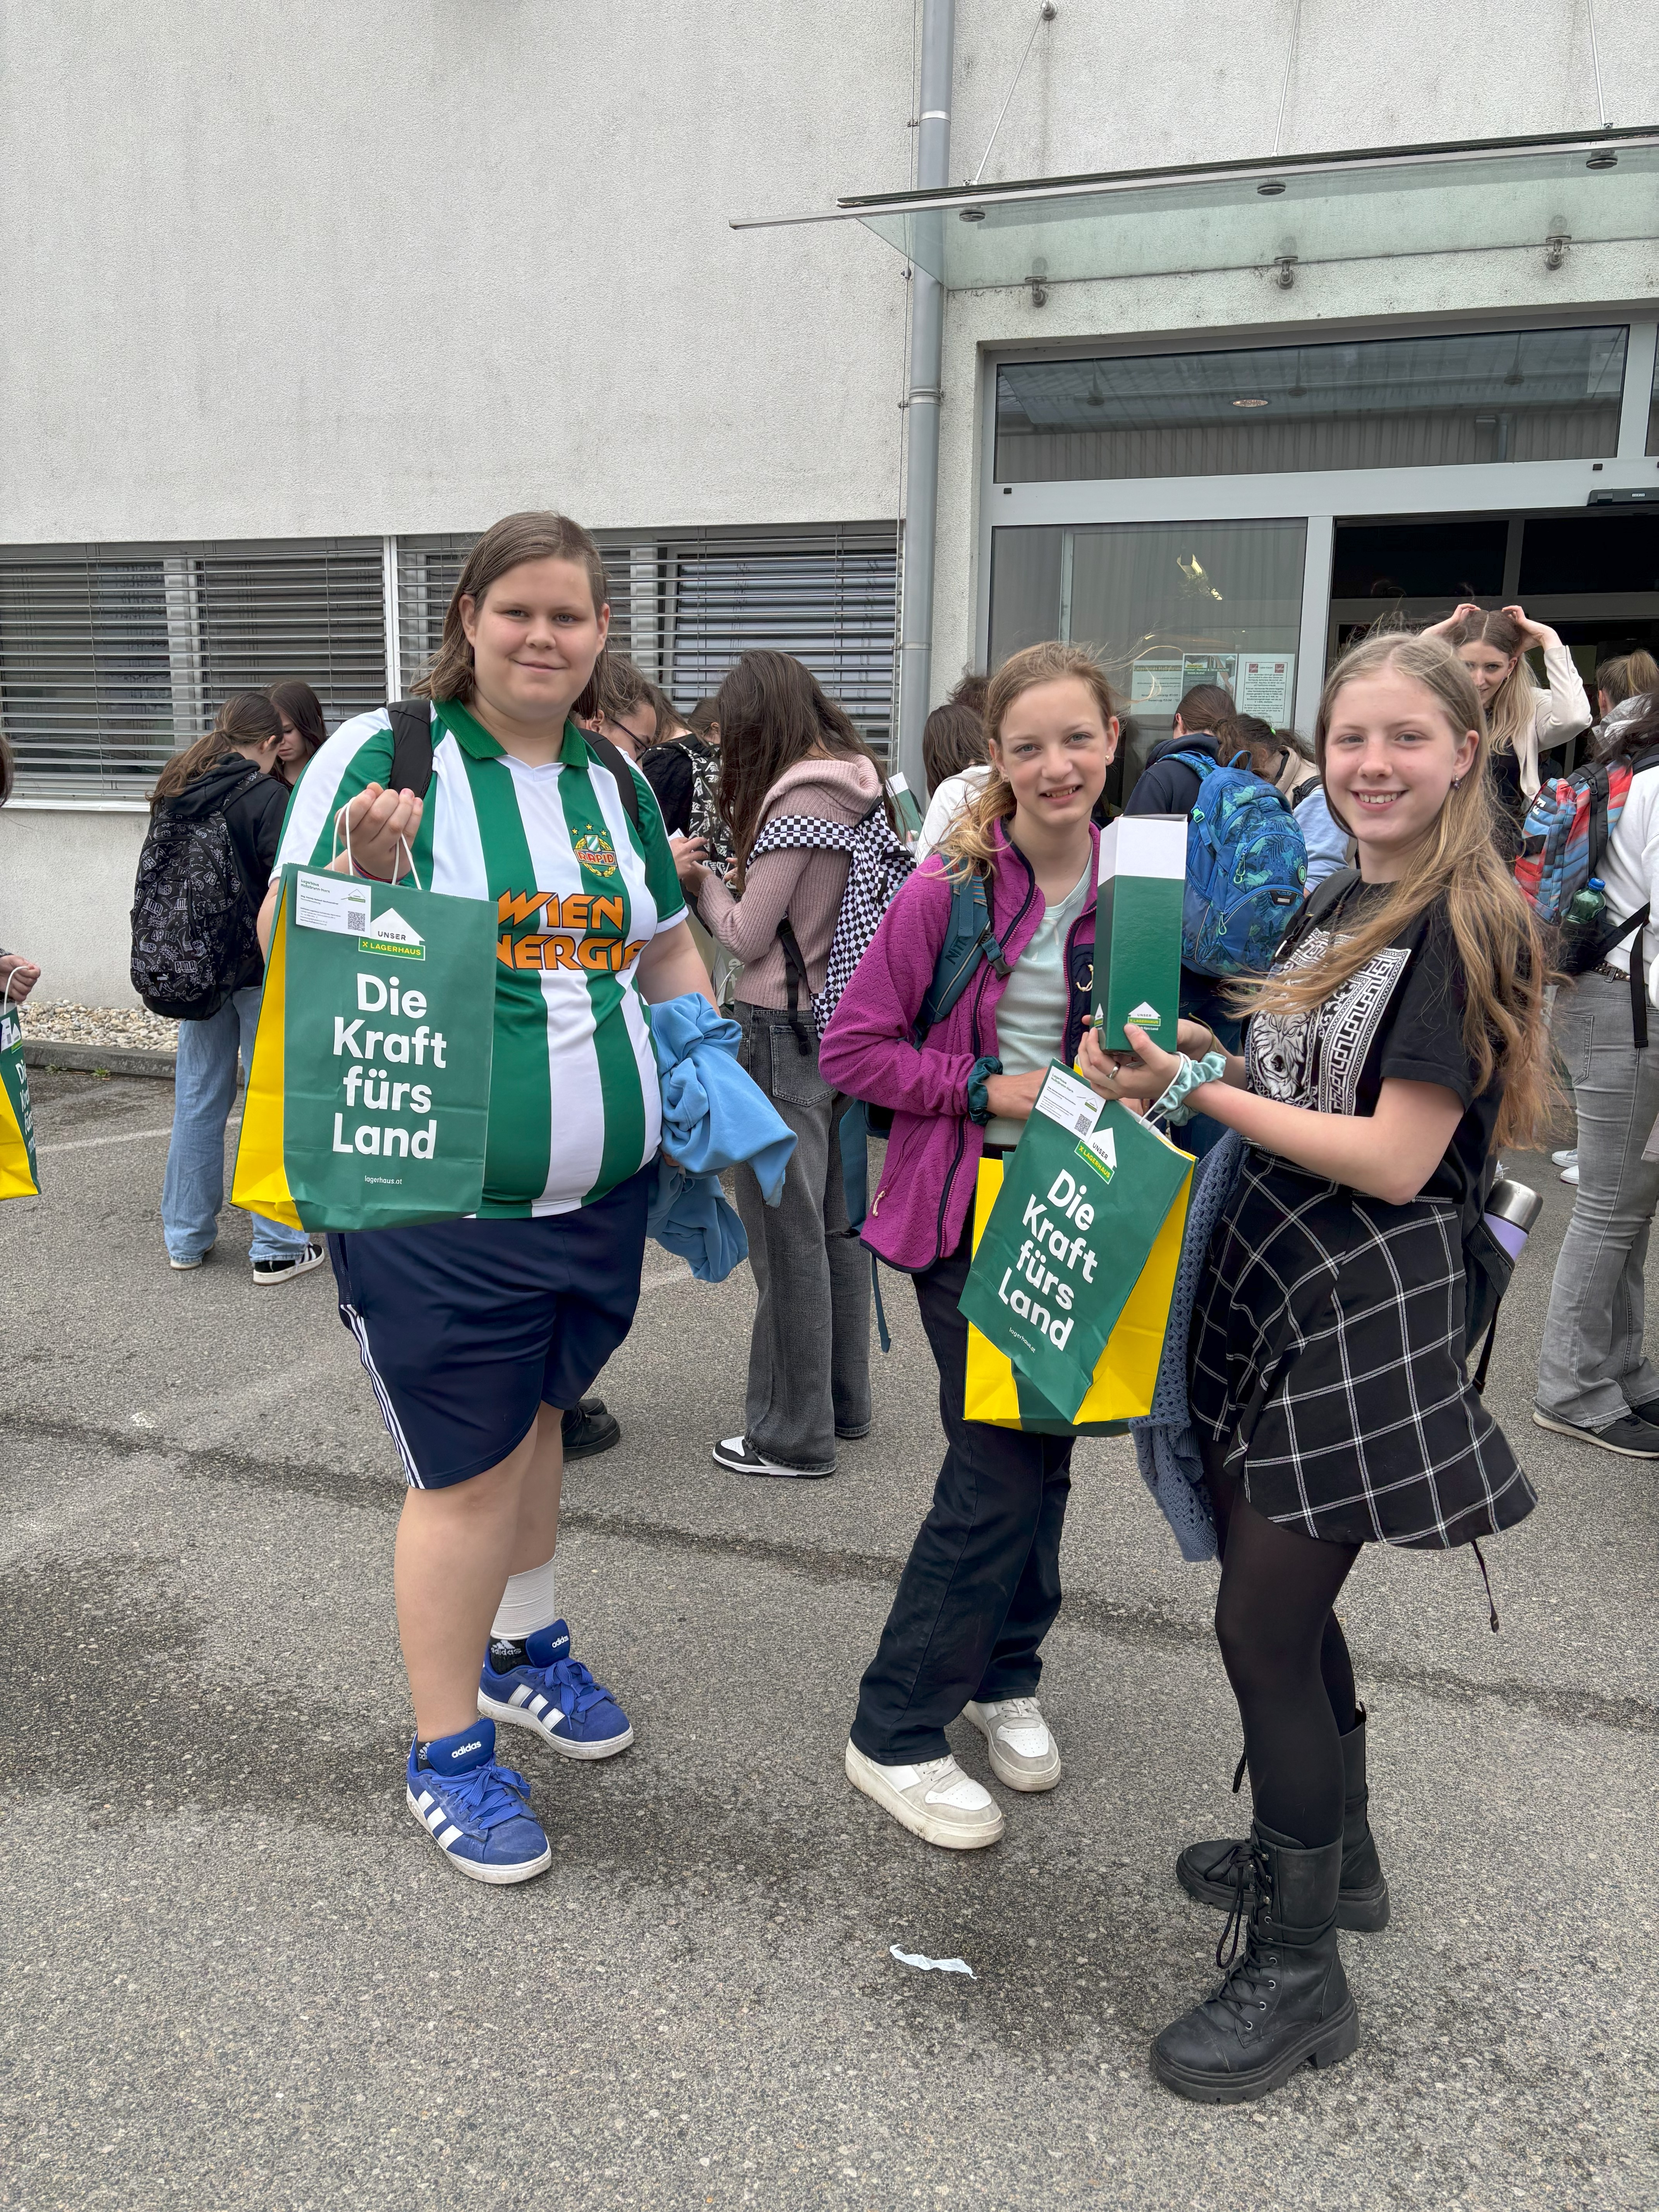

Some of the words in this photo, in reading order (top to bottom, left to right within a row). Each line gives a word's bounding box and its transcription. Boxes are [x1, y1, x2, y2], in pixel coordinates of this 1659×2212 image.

[143, 856, 156, 871] 48
[576, 851, 614, 864] RAPID
[203, 871, 218, 886] 48
[498, 887, 623, 931] WIEN
[378, 931, 406, 941] UNSER
[370, 943, 421, 955] LAGERHAUS
[357, 973, 426, 1018] Die
[333, 1017, 447, 1068] Kraft
[343, 1066, 432, 1113] fürs
[333, 1113, 436, 1159] Land
[1092, 1142, 1108, 1160] UNSER
[1083, 1149, 1111, 1178] LAGERHAUS
[365, 1175, 402, 1184] lagerhaus.at
[1047, 1169, 1094, 1231] Die
[1023, 1194, 1097, 1283] Kraft
[1017, 1240, 1074, 1310] fürs
[998, 1267, 1074, 1351] Land
[491, 1647, 522, 1656] adidas
[552, 1635, 569, 1649] adidas
[452, 1741, 482, 1759] adidas
